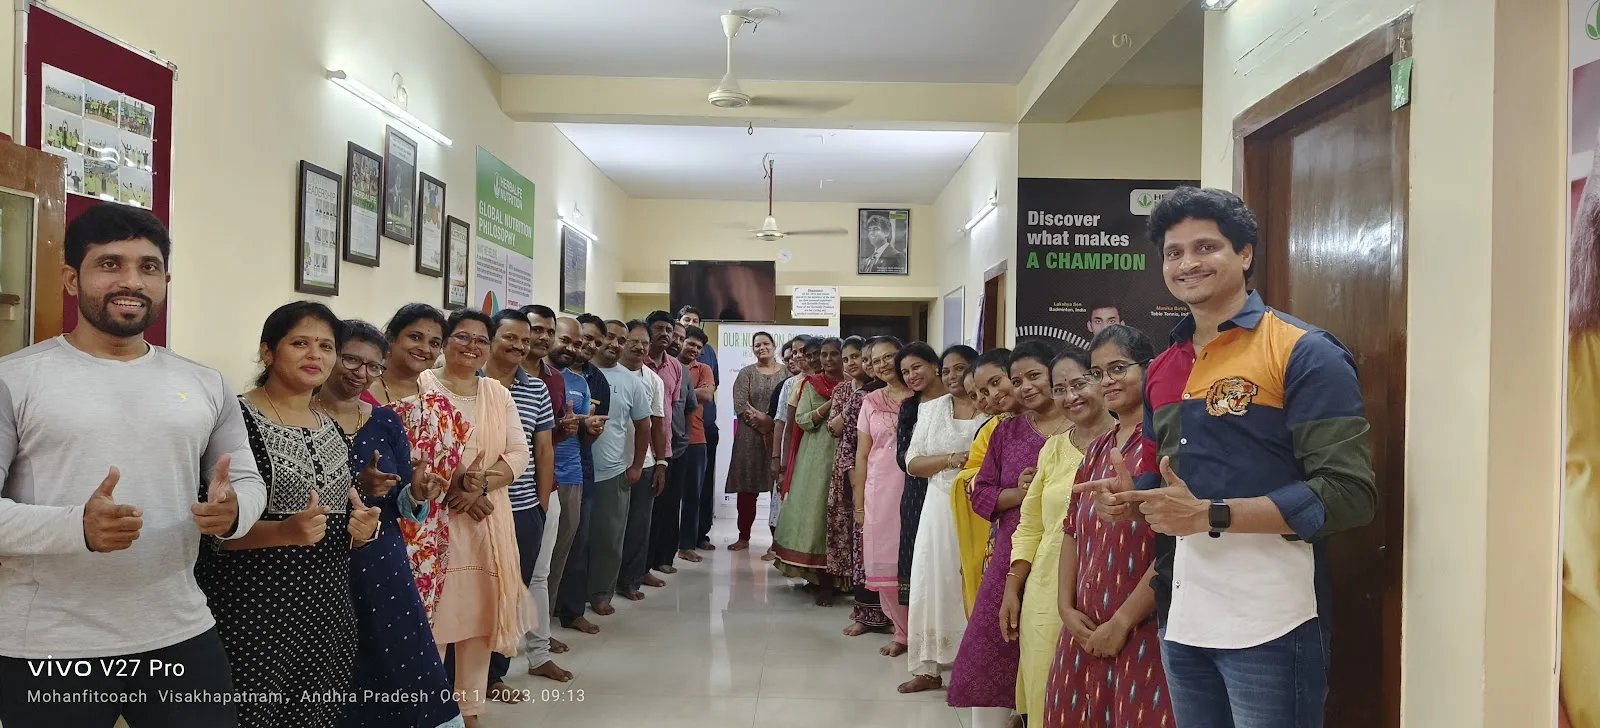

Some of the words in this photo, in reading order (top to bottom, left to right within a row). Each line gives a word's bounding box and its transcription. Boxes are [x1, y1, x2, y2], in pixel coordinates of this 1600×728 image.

[478, 200, 503, 225] GLOBAL
[504, 213, 532, 239] NUTRITION
[1027, 210, 1101, 227] Discover
[478, 217, 516, 246] PHILOSOPHY
[1027, 230, 1070, 246] what
[1074, 231, 1130, 247] makes
[1026, 251, 1040, 269] A
[1046, 252, 1146, 271] CHAMPION
[723, 332, 740, 347] OUR
